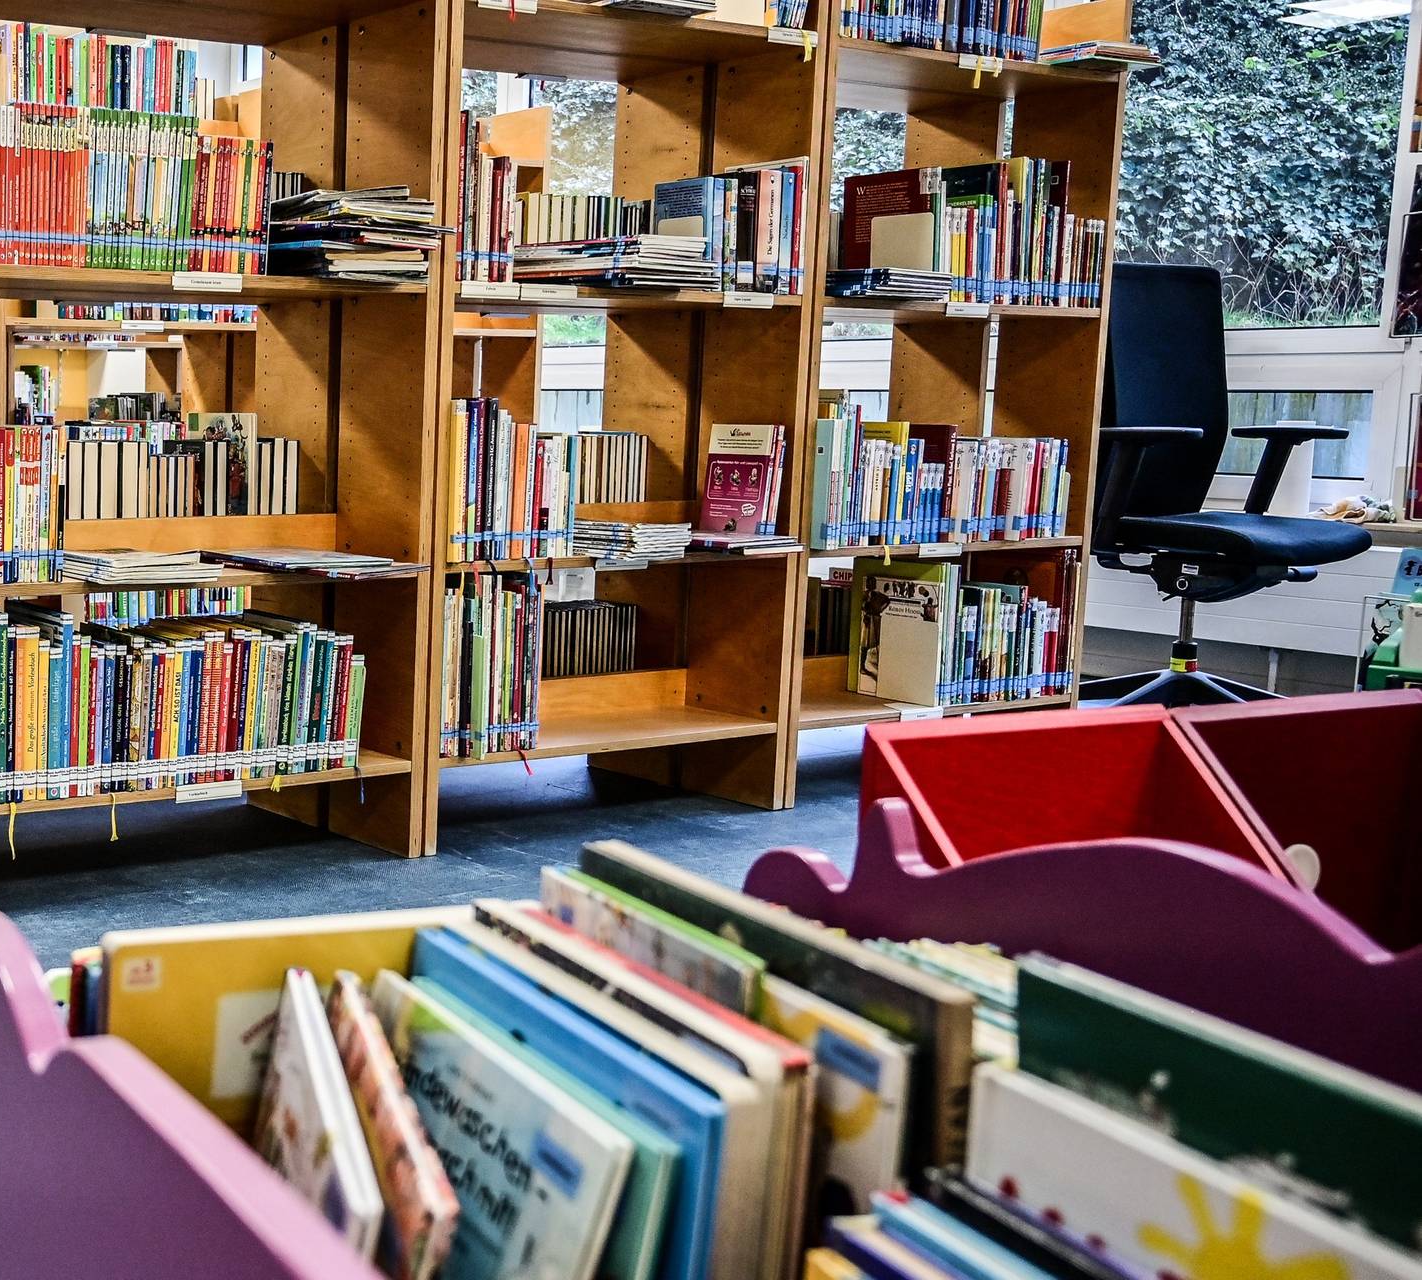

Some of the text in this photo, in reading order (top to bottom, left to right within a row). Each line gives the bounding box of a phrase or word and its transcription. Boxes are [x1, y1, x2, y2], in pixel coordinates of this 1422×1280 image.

[833, 571, 852, 581] CHIP
[173, 700, 180, 708] SO
[27, 722, 36, 740] große
[27, 741, 35, 753] Das
